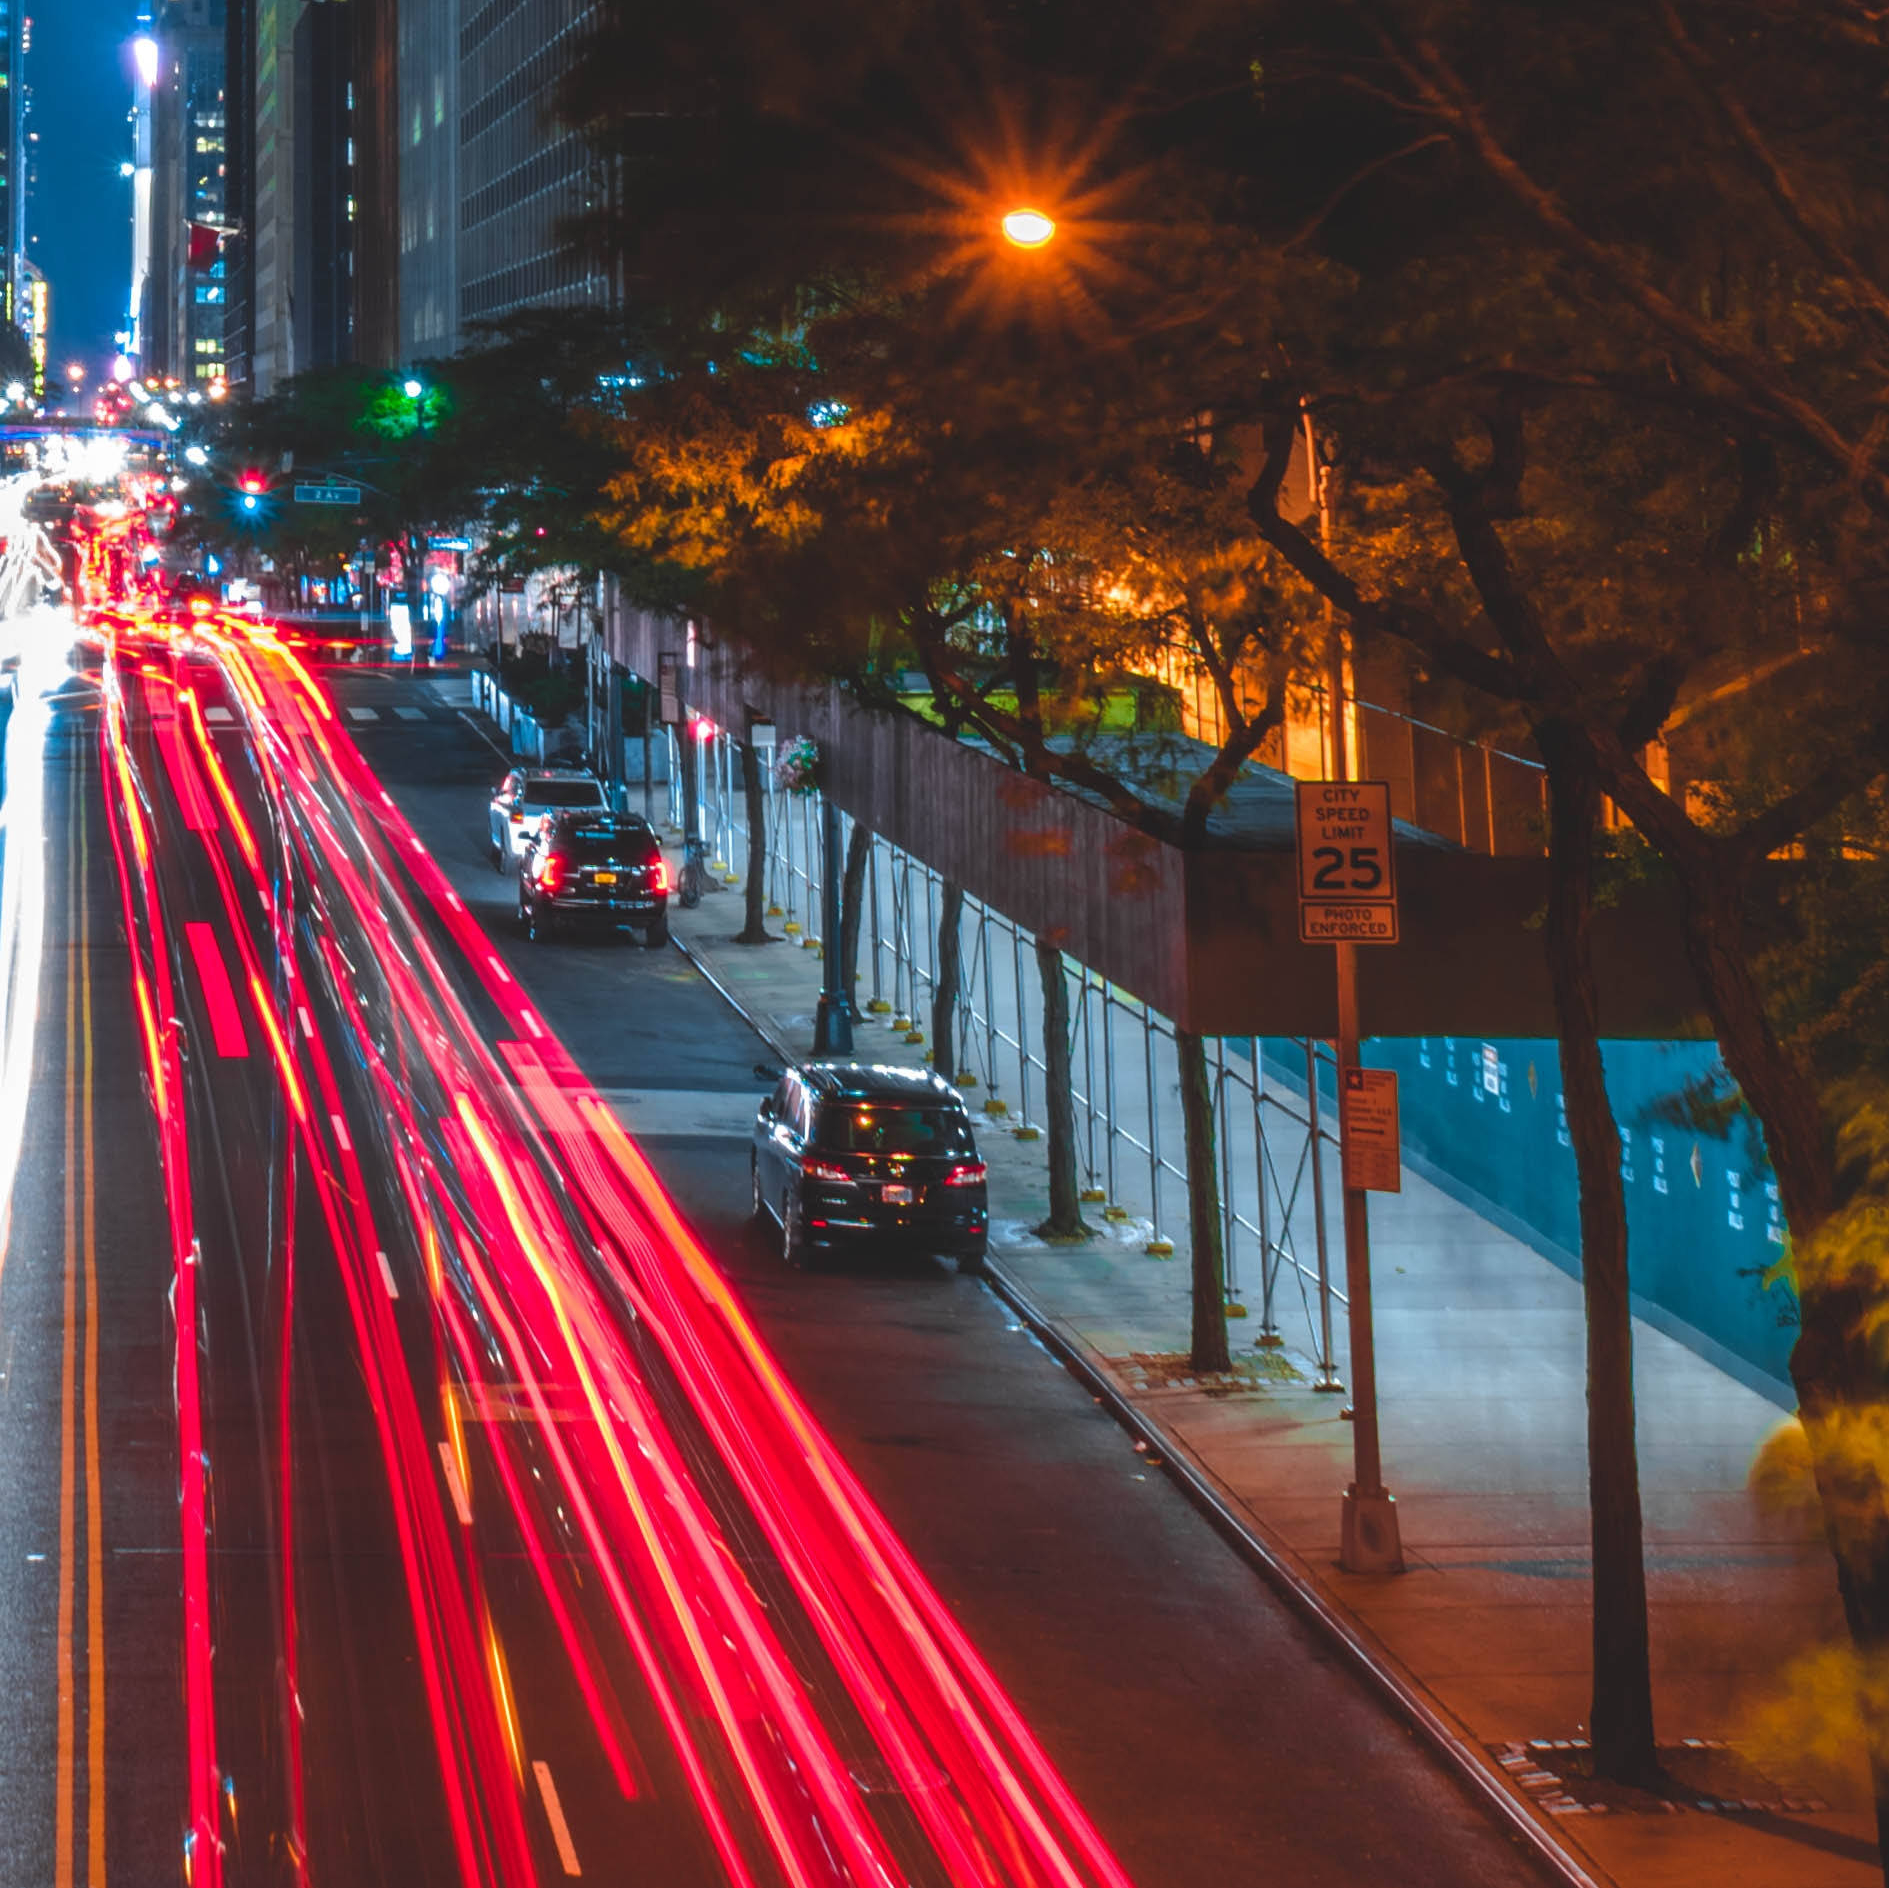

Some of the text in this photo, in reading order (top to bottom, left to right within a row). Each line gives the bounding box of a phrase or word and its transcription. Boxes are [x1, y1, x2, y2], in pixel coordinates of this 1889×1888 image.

[1323, 789, 1360, 803] CITY
[1316, 807, 1370, 822] SPEED
[1322, 826, 1365, 840] LIMIT
[1313, 846, 1382, 890] 25
[1324, 909, 1372, 921] PHOTO
[1310, 922, 1388, 935] ENFORCED
